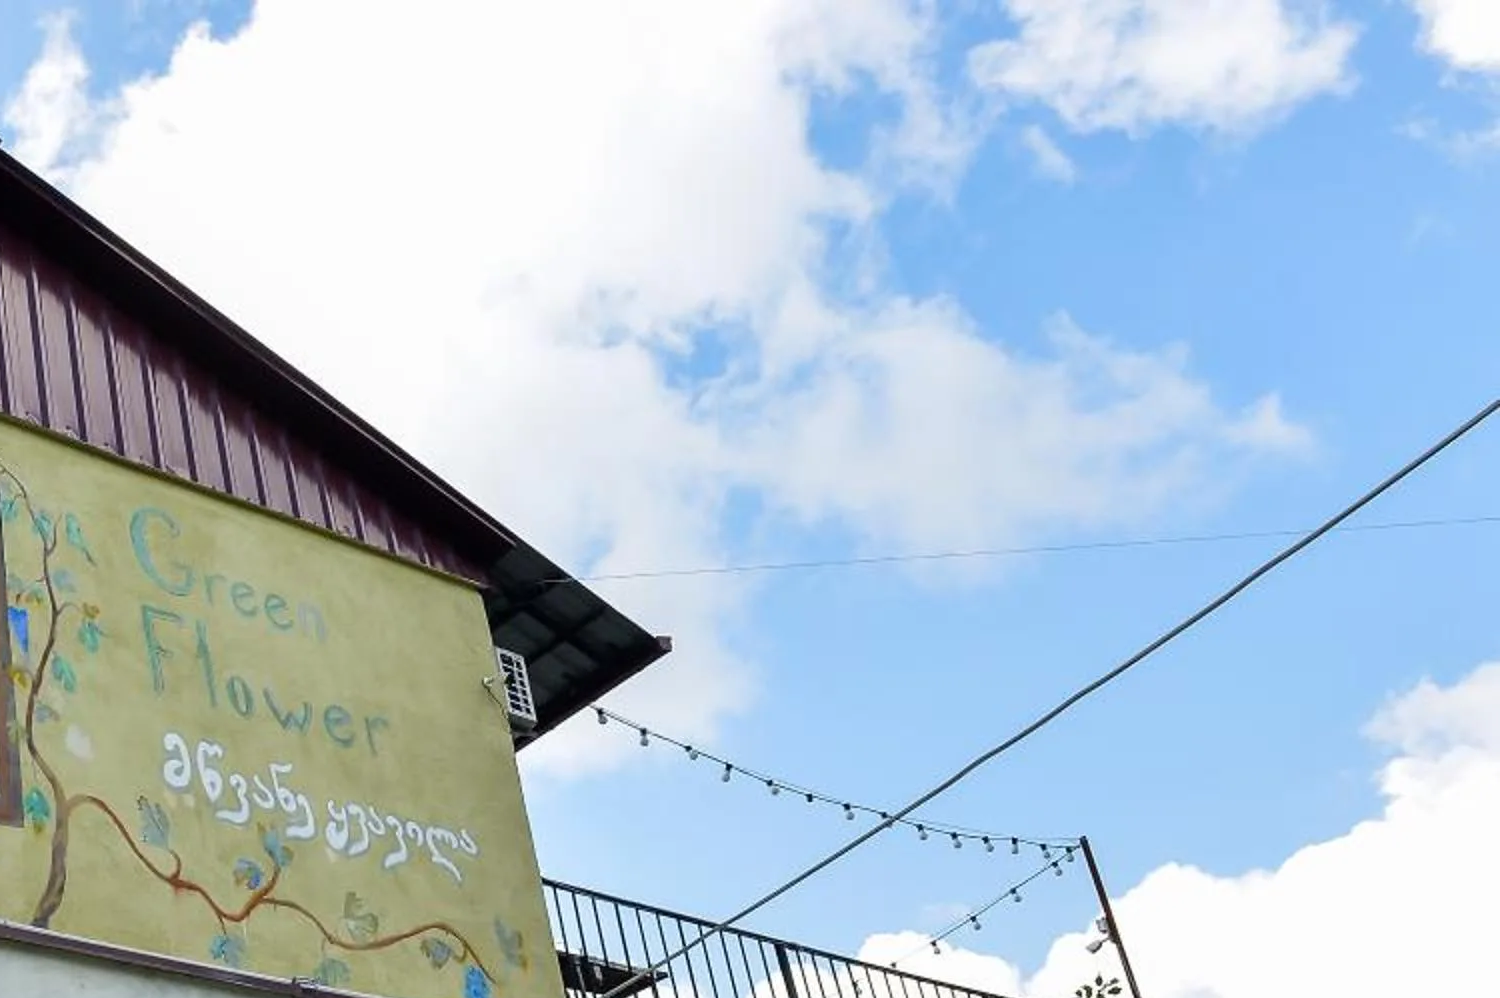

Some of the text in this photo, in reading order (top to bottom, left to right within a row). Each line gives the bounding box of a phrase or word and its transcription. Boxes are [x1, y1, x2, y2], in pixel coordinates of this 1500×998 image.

[129, 507, 329, 643] Green
[140, 604, 391, 755] Flower
[163, 732, 316, 839] მწვანე
